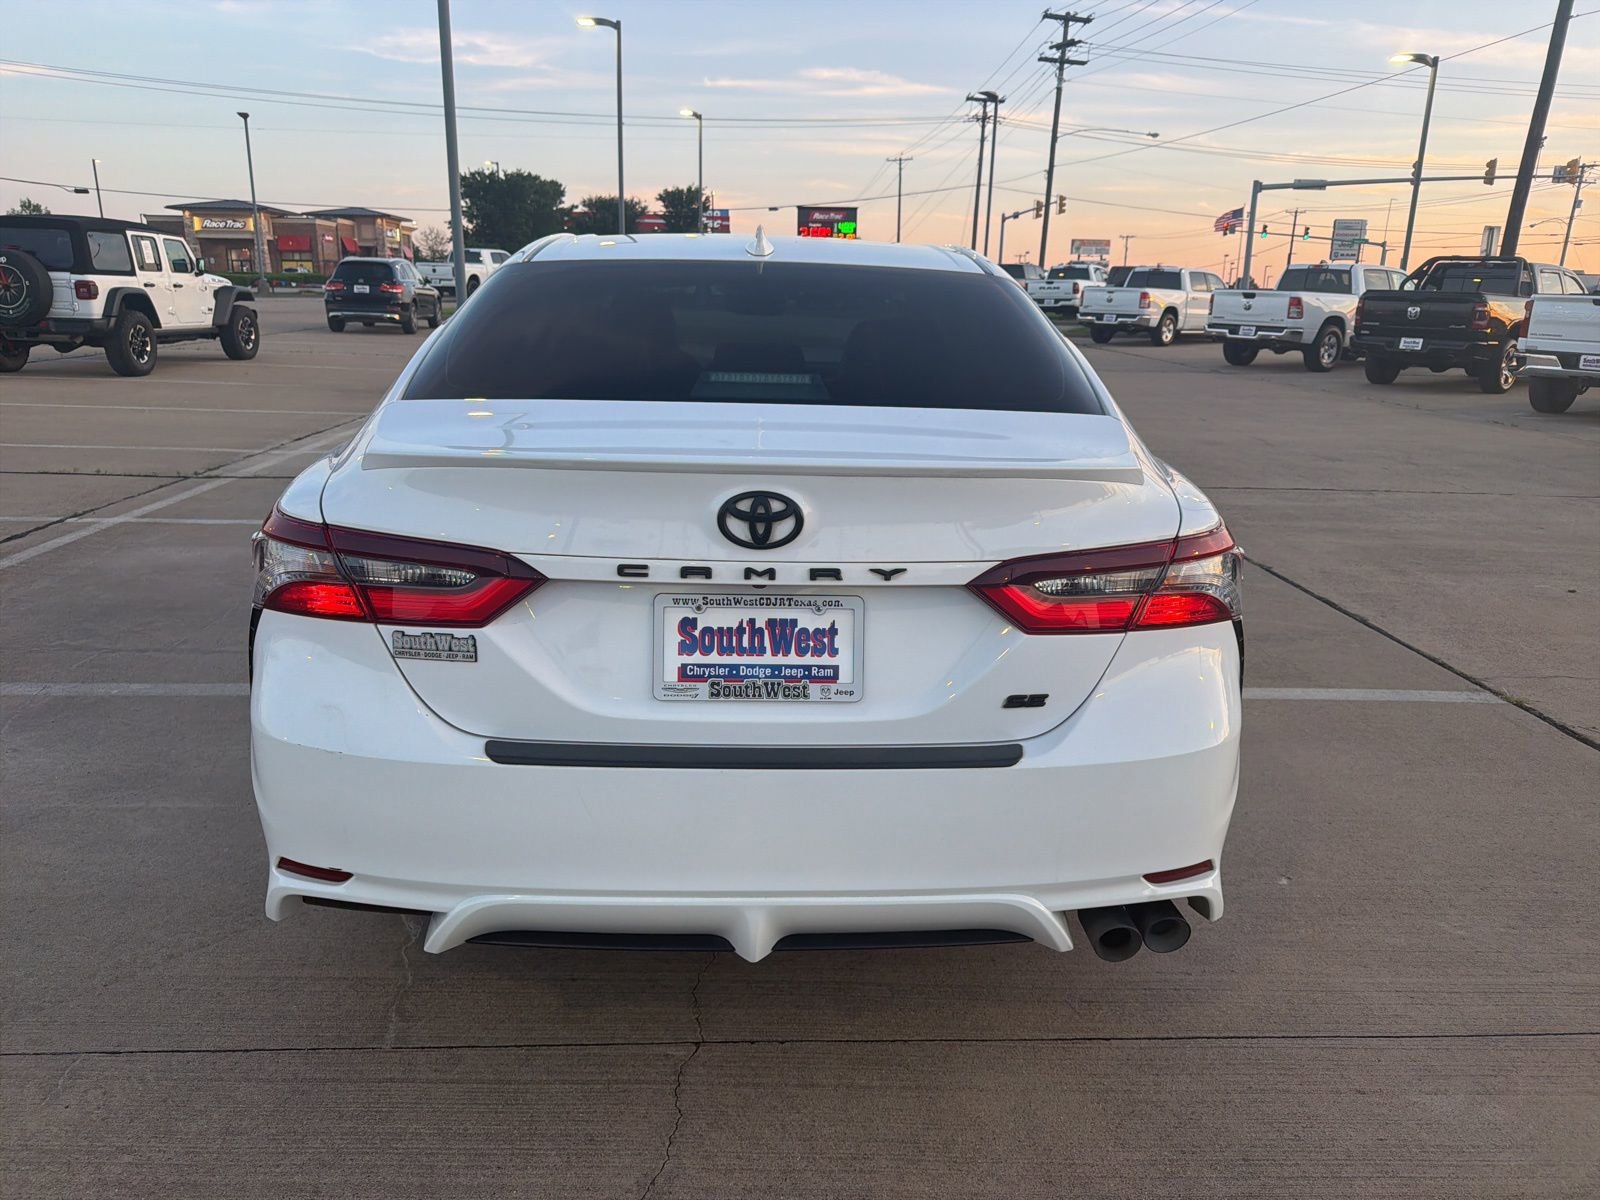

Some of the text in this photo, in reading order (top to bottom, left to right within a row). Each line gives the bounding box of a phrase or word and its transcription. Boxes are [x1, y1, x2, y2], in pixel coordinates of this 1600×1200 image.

[202, 219, 246, 229] RaceTrac
[617, 564, 907, 581] CAMRY
[392, 630, 476, 652] SouthWest
[677, 616, 839, 658] SouthWest
[686, 665, 834, 678] Chrysler Dodge Jeep Ram
[708, 680, 810, 699] SouthWest
[833, 688, 855, 697] Jeep
